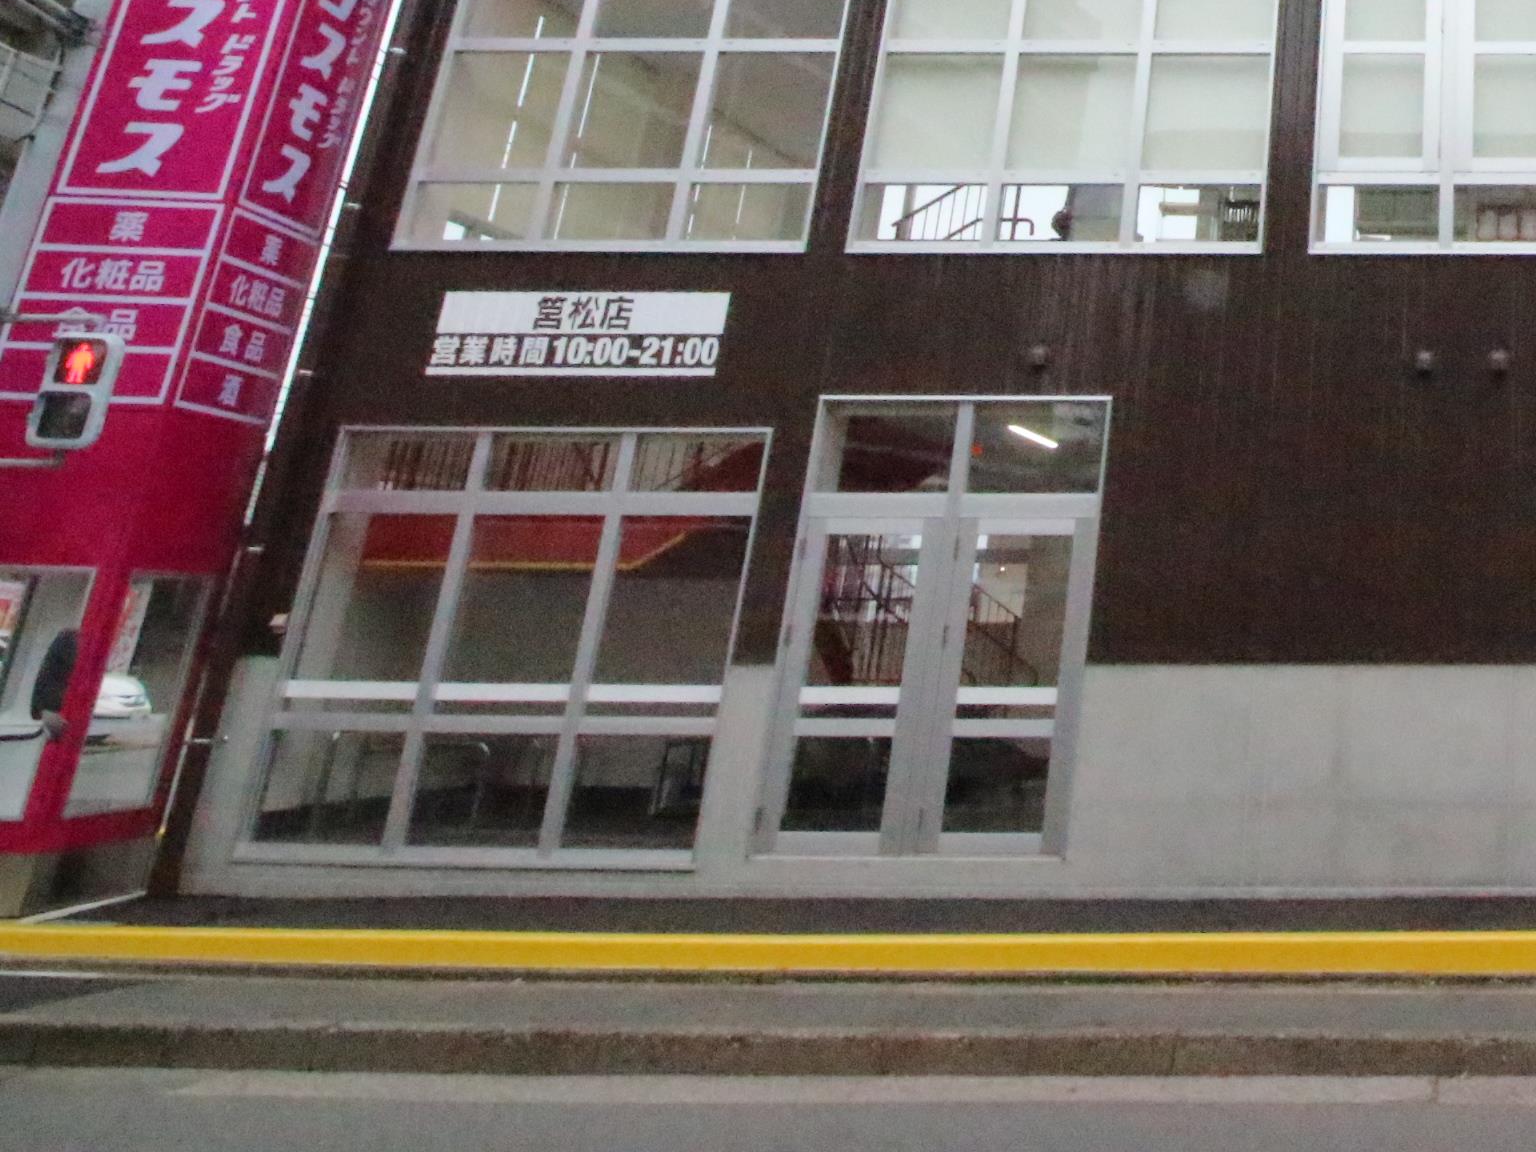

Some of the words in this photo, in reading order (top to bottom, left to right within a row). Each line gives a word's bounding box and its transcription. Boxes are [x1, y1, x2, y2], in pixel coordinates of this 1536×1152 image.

[194, 34, 257, 113] ドラッグ
[109, 211, 148, 242] 薬
[60, 257, 166, 293] 化粧品
[229, 275, 286, 317] 化粧品
[218, 323, 267, 363] 食品
